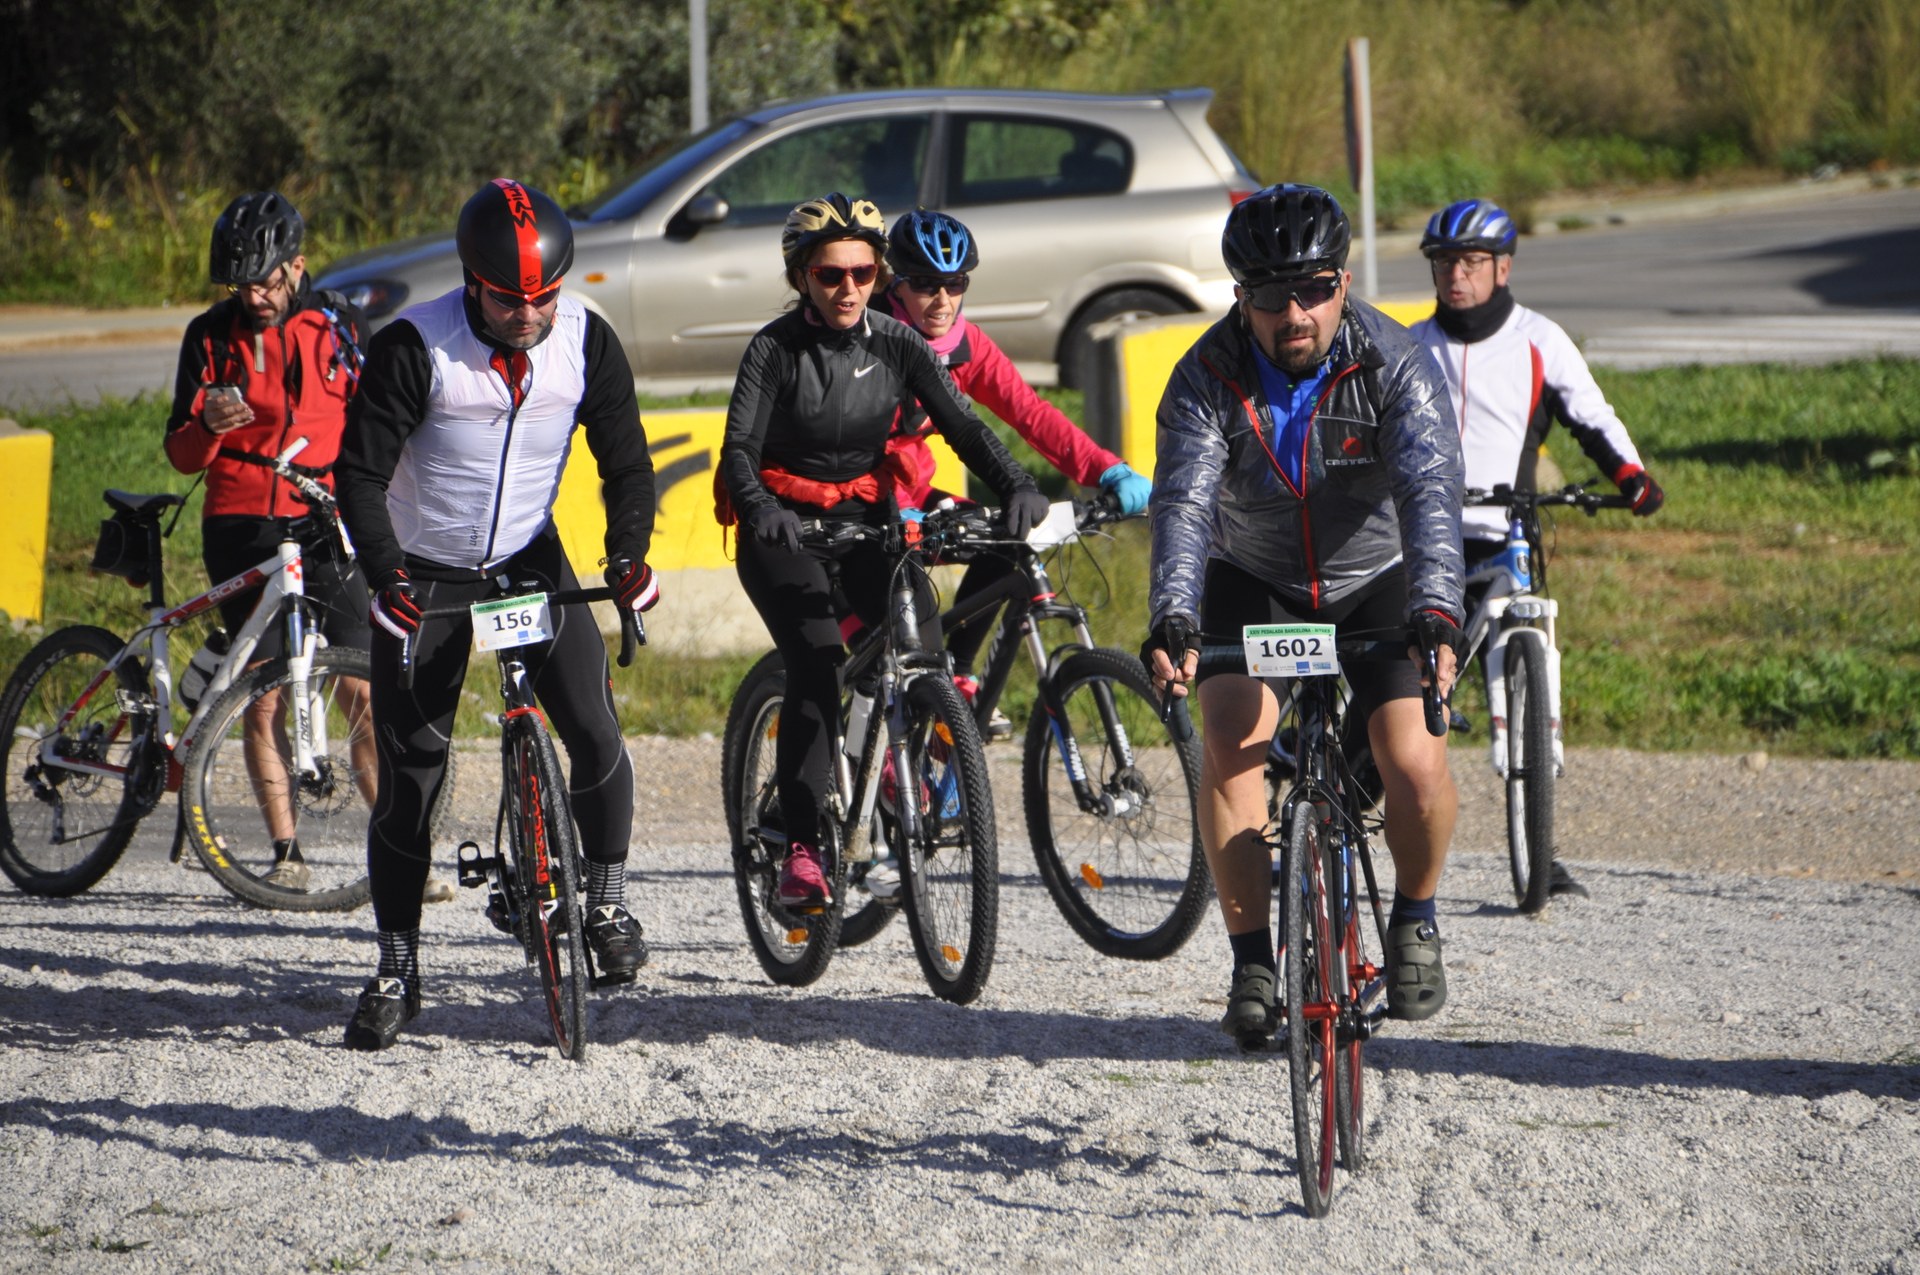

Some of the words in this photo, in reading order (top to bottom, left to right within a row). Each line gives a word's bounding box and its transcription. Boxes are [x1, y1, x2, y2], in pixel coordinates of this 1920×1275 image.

[1325, 456, 1376, 466] CASTELL
[493, 610, 532, 631] 156
[1260, 637, 1323, 658] 1602
